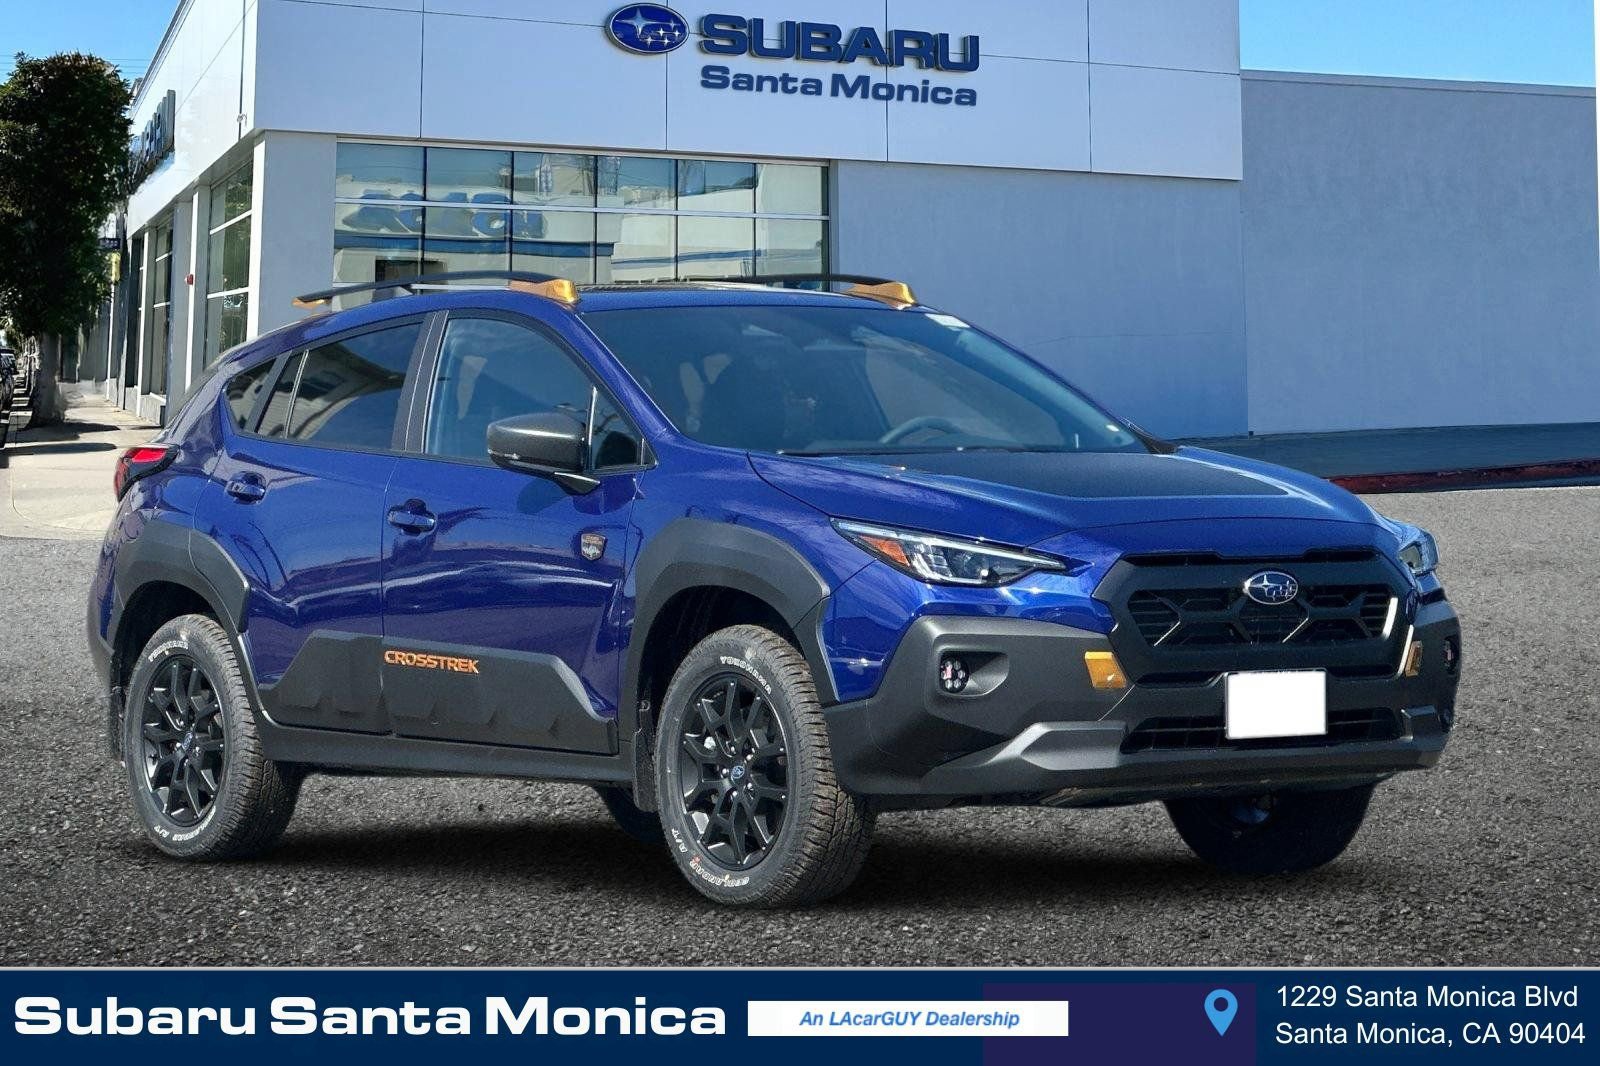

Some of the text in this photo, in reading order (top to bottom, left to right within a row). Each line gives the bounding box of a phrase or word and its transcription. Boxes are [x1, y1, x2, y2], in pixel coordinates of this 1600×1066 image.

[699, 12, 981, 73] SUBARU
[700, 64, 978, 107] Santa Monica
[384, 650, 480, 675] CROSSTREK
